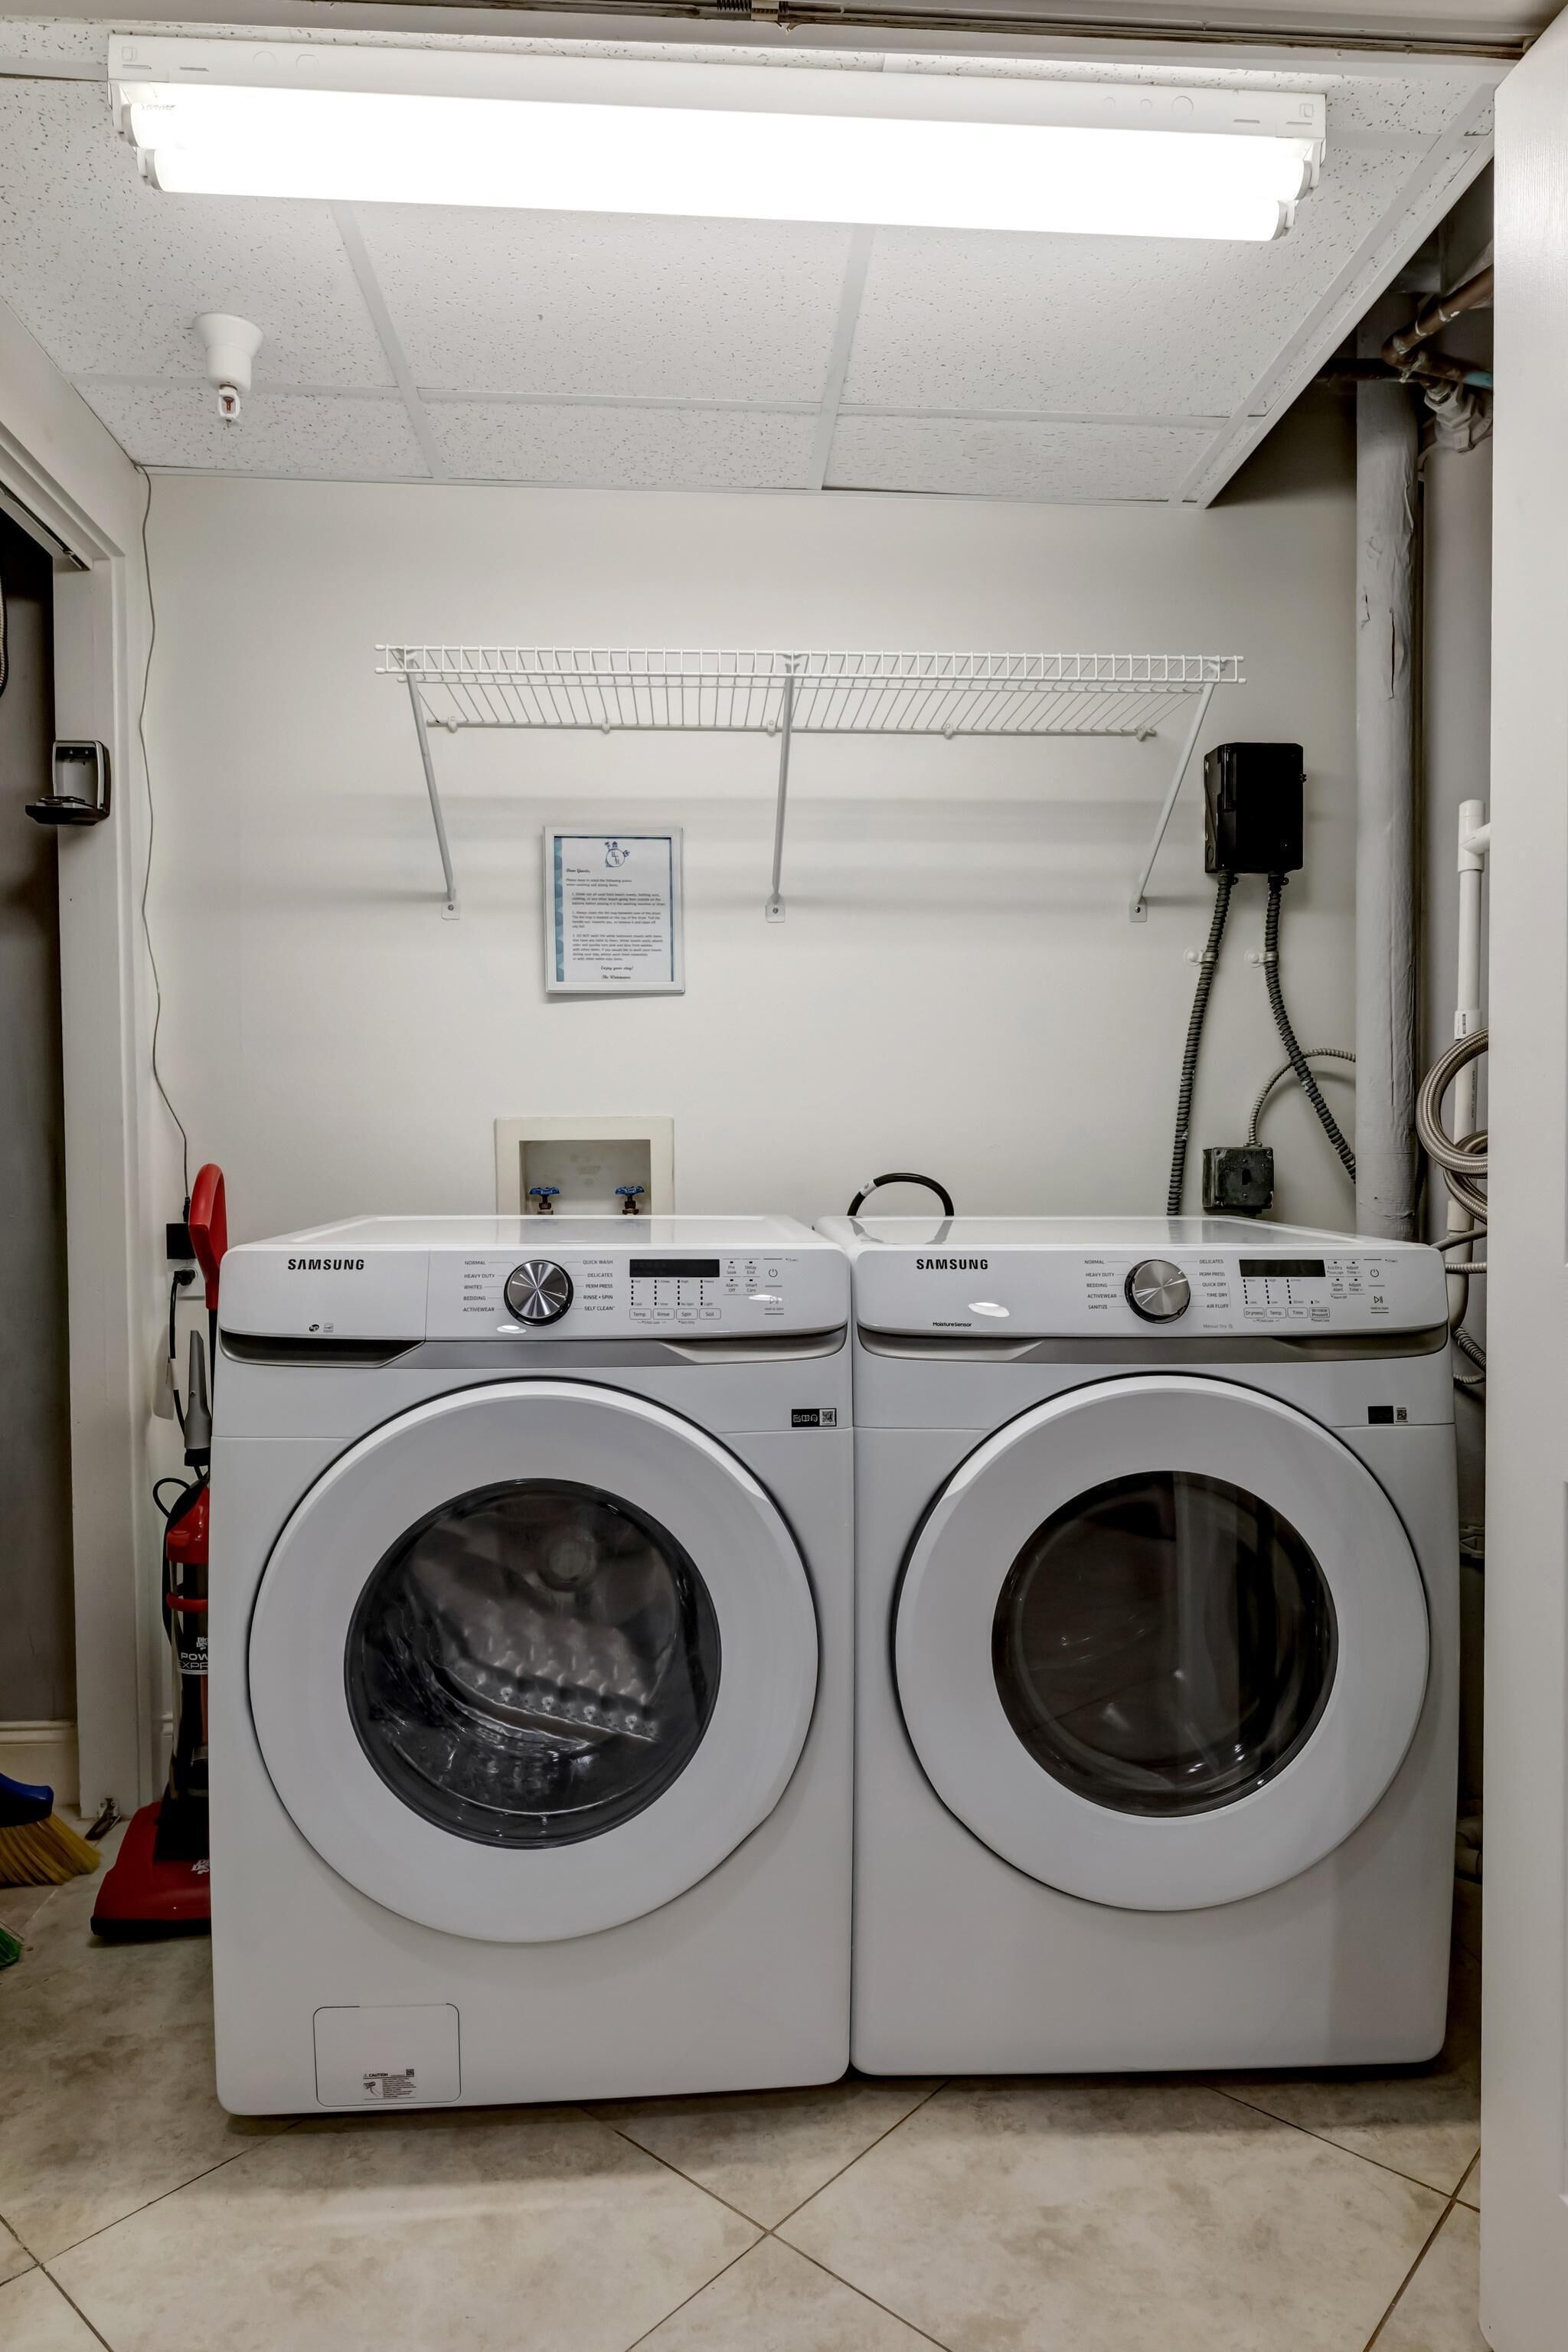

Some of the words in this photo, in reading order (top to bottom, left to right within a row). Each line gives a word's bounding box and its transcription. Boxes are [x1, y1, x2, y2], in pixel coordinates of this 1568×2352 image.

[288, 1259, 364, 1271] SAMSUNG
[916, 1259, 988, 1270] SAMSUNG
[181, 1652, 208, 1661] POW
